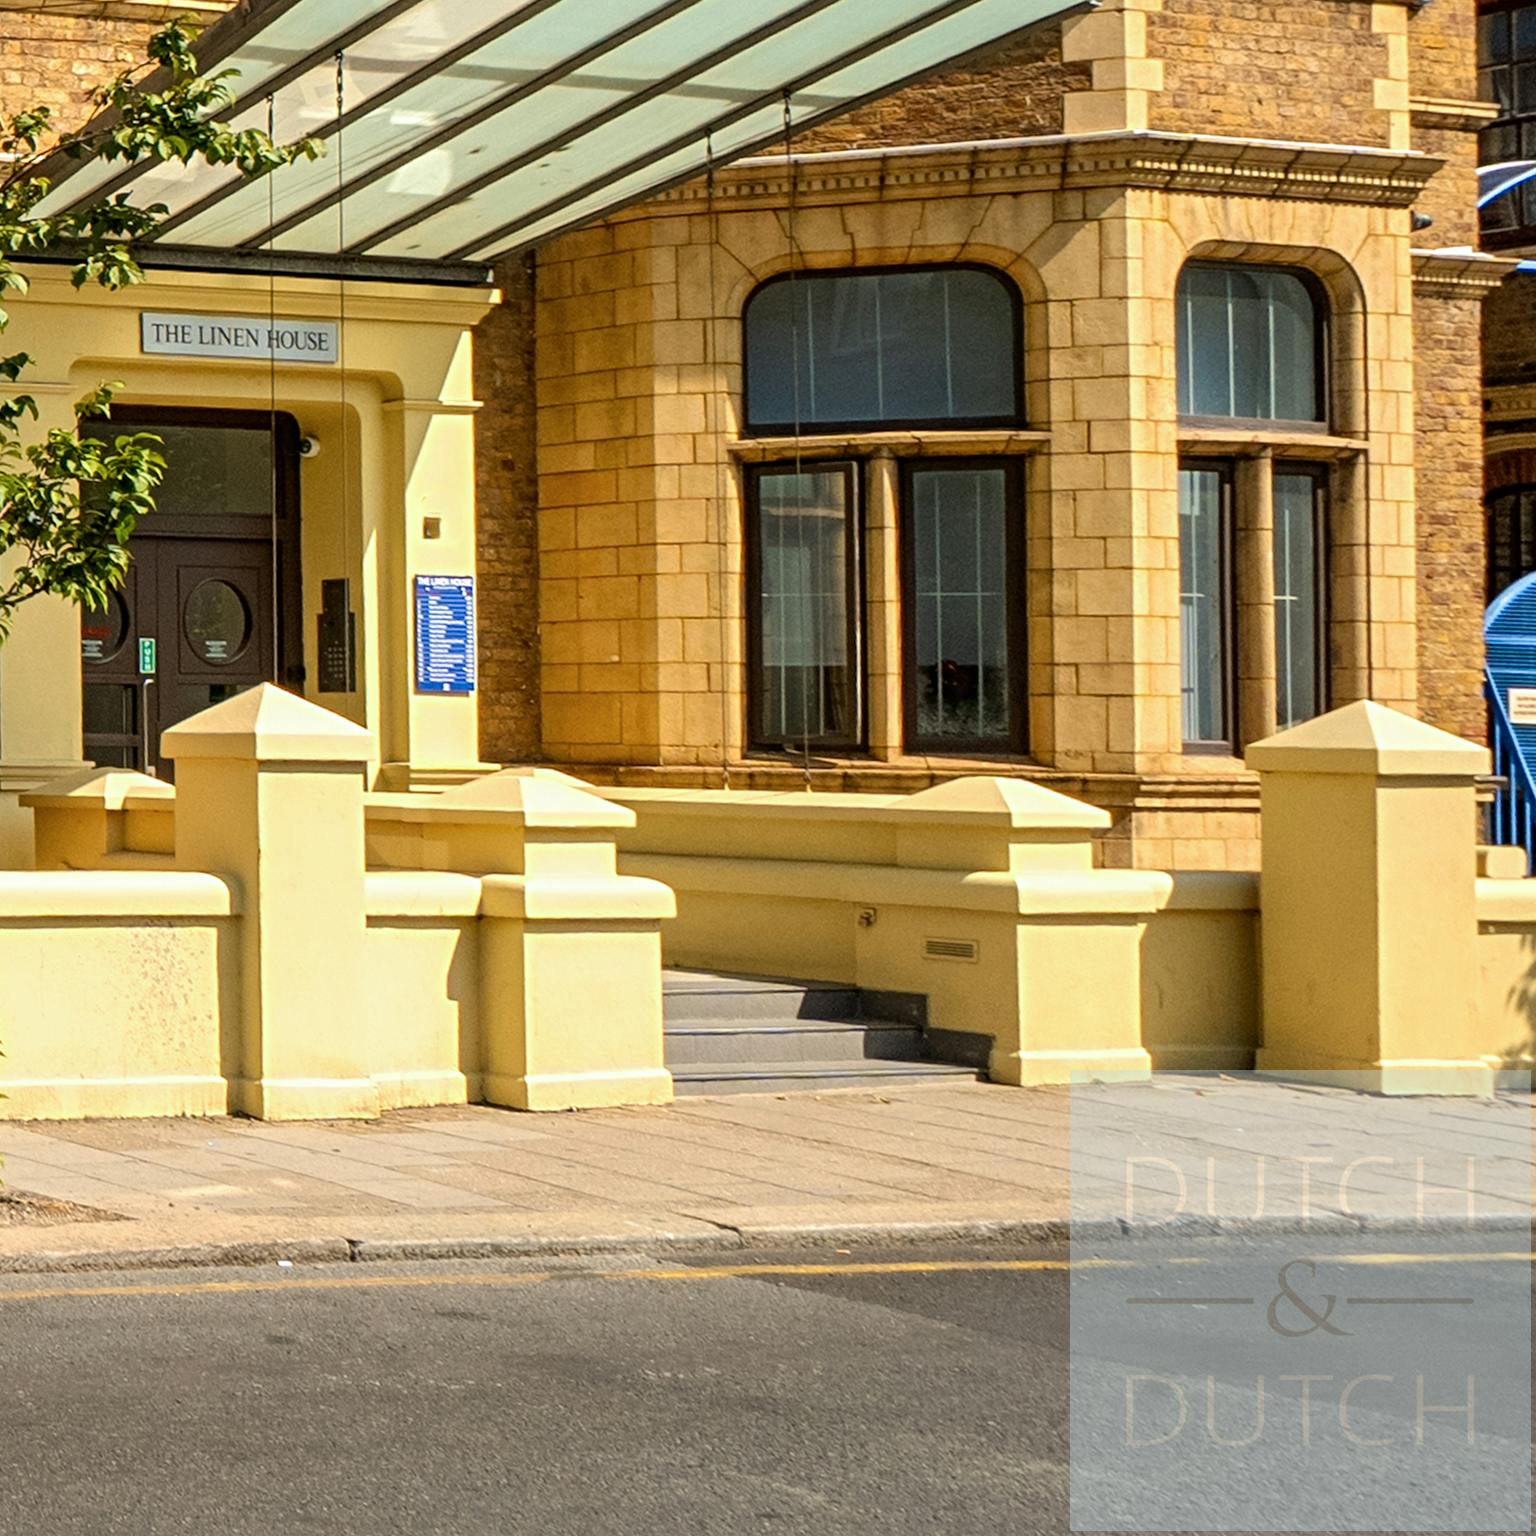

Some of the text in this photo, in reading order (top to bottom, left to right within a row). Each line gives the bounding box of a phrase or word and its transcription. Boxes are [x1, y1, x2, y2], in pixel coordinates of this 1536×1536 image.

[151, 323, 329, 352] THE LINEN HOUSE
